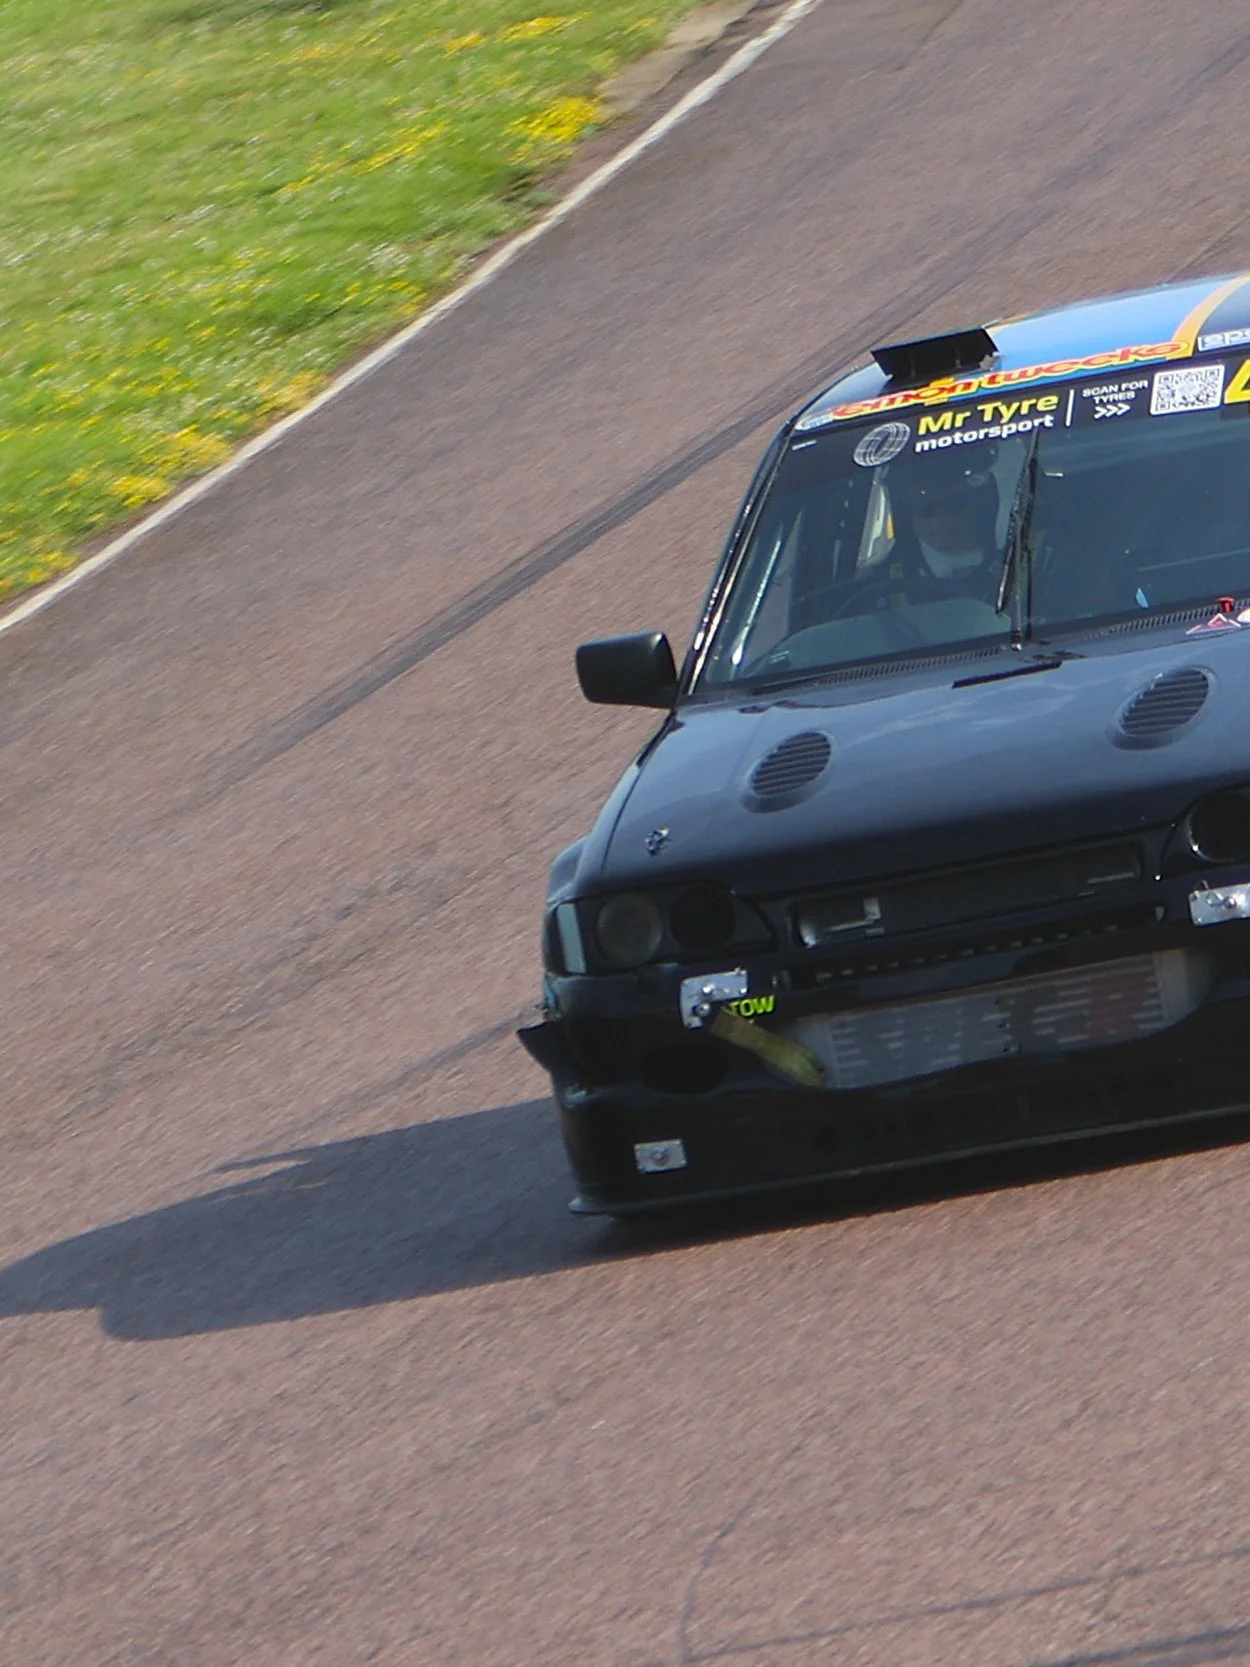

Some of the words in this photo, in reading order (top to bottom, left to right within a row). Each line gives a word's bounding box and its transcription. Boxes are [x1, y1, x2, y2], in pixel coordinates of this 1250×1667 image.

[806, 377, 977, 427] emon
[1082, 384, 1119, 398] SCAN
[1121, 380, 1148, 391] FOR
[1093, 391, 1136, 404] TYRES
[917, 411, 971, 436] Mr
[977, 394, 1059, 424] Tyre
[915, 414, 1054, 452] motorsport
[729, 995, 775, 1016] TOW
